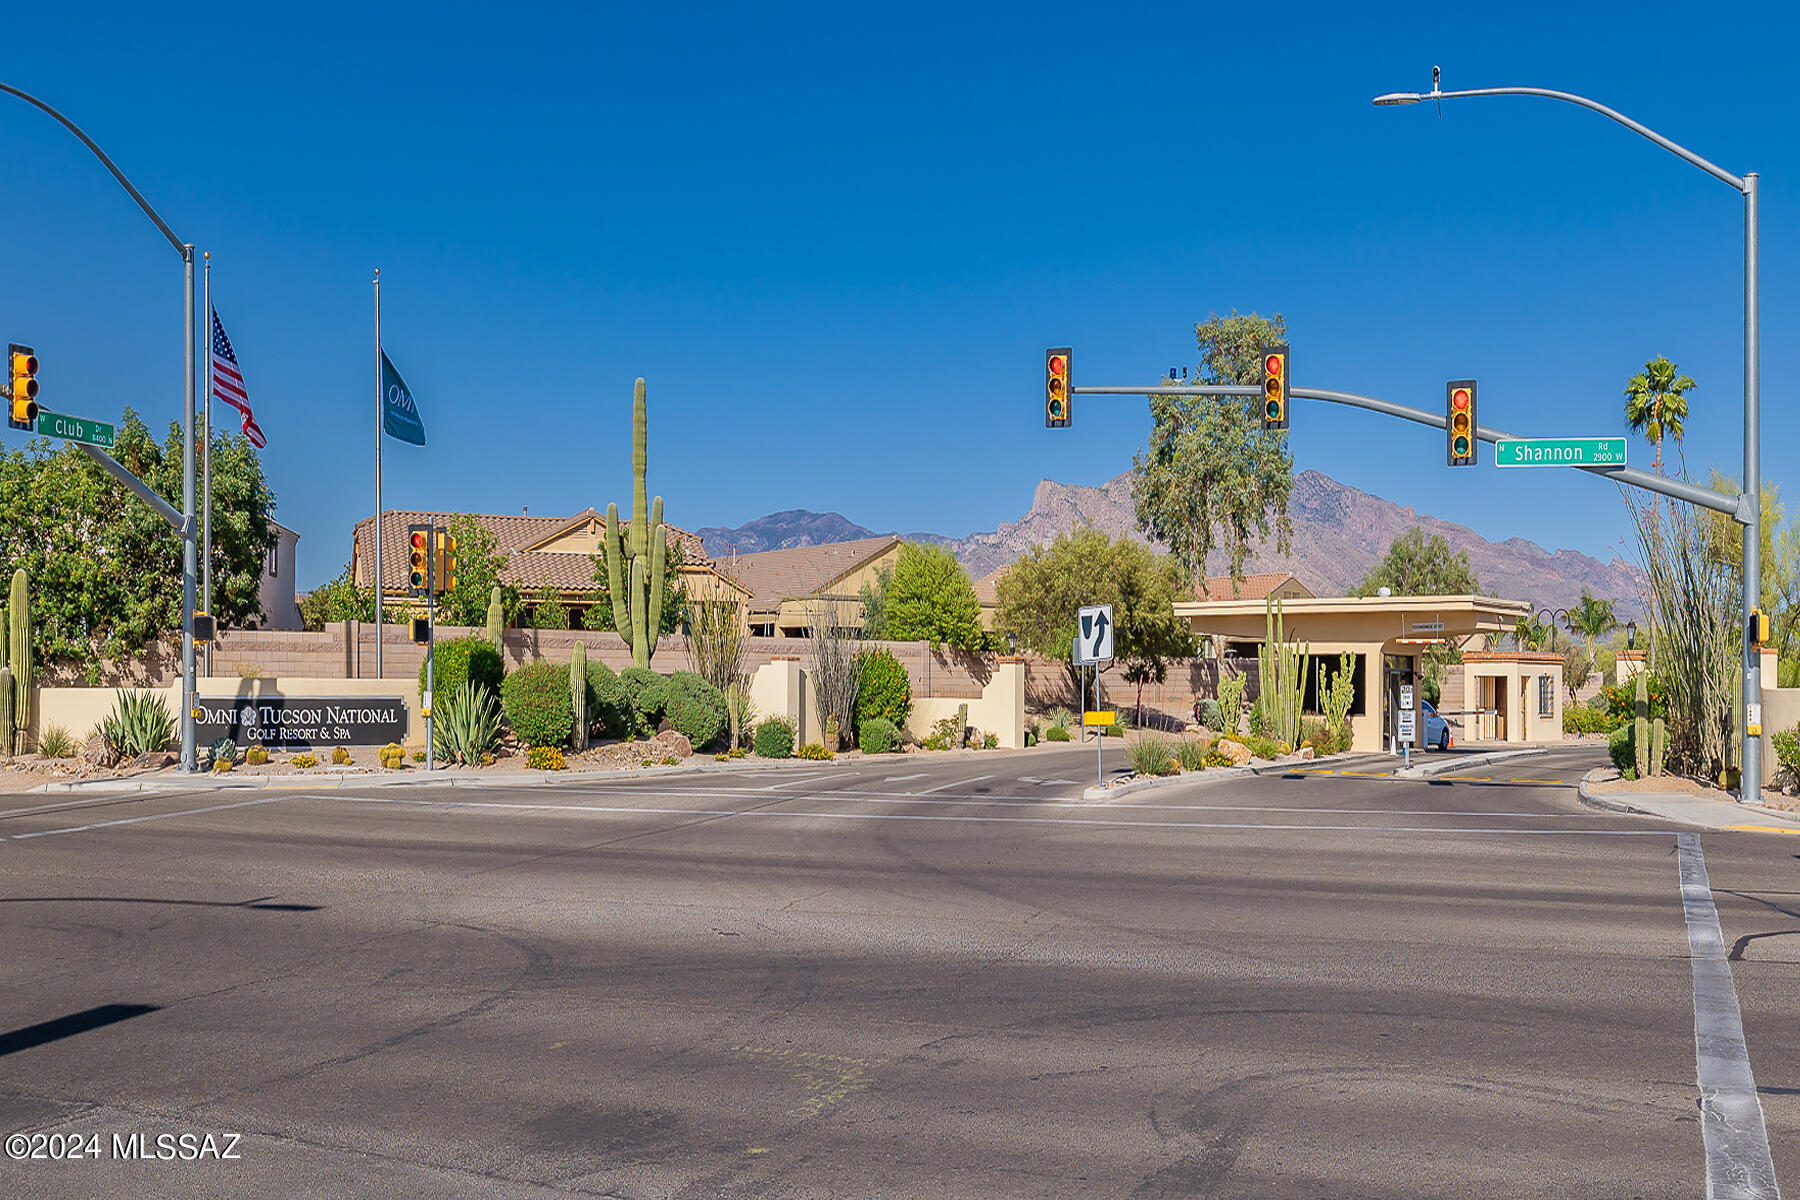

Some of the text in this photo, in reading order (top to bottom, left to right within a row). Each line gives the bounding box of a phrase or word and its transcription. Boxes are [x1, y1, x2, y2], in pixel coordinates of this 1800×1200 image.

[55, 419, 83, 438] Club
[95, 424, 102, 433] Dr
[1498, 442, 1608, 461] N Shannon Rd
[1593, 452, 1623, 461] 2900 W
[195, 705, 398, 724] OMNI TUCSON NATIONAL
[246, 726, 351, 740] GOLF RESORT & SPA
